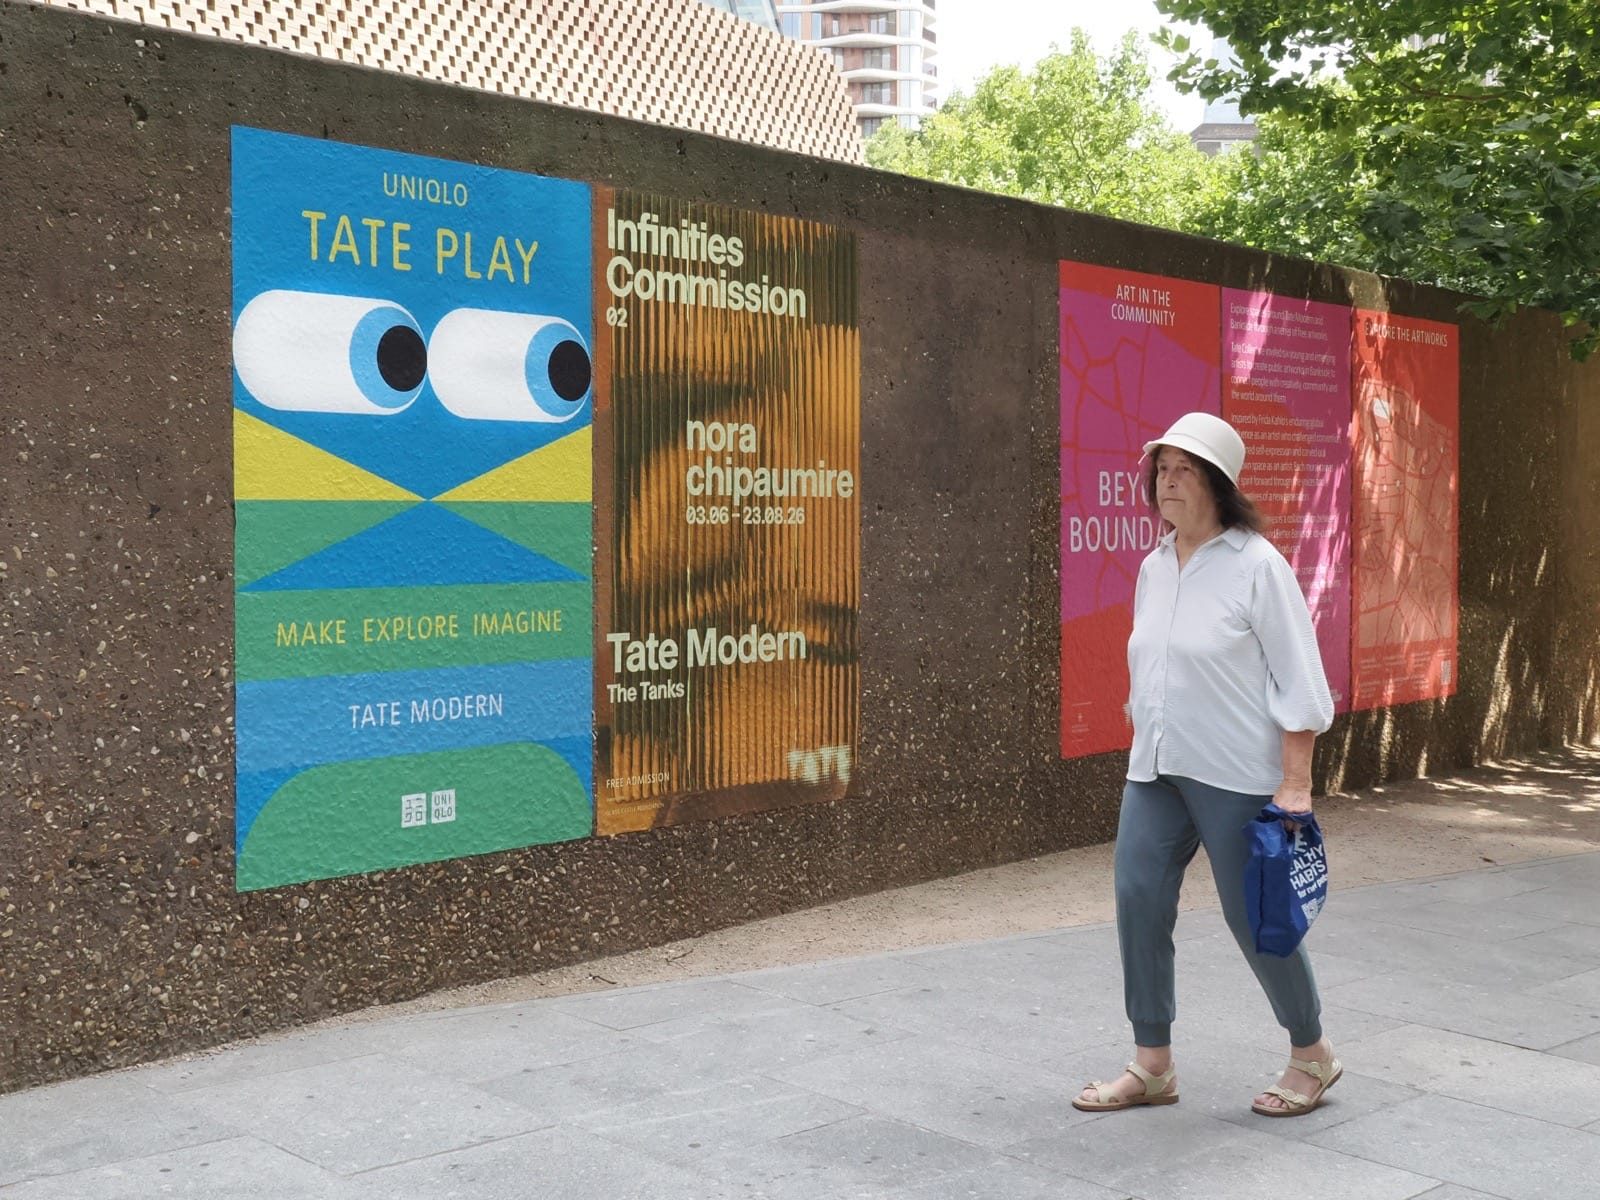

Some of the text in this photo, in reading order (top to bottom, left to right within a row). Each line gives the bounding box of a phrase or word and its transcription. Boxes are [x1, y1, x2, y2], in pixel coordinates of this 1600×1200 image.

[383, 171, 468, 207] UNIQLO
[302, 210, 539, 284] TATE PLAY
[607, 208, 744, 267] Infinities
[606, 256, 806, 318] Commission
[1116, 284, 1170, 307] ART IN THE
[606, 307, 628, 328] 02
[1111, 303, 1175, 326] COMMUNITY
[1397, 327, 1410, 342] THE
[1411, 329, 1448, 347] ARTWORKS
[686, 419, 757, 453] nora
[686, 455, 854, 506] chipaumire
[1099, 471, 1150, 507] BEY
[686, 505, 729, 525] 03.06
[743, 506, 805, 525] 23.08.26
[1069, 516, 1167, 553] BOUNDA
[276, 609, 563, 648] MAKE EXPLORE IMAGINE
[606, 624, 807, 673] Tate Modern
[606, 679, 685, 703] The Tanks
[349, 694, 503, 729] TATE MODERN
[606, 772, 670, 789] FREE ADMISSION
[433, 792, 451, 806] UNI
[434, 806, 453, 821] QLO
[1290, 844, 1324, 876] ALTHY
